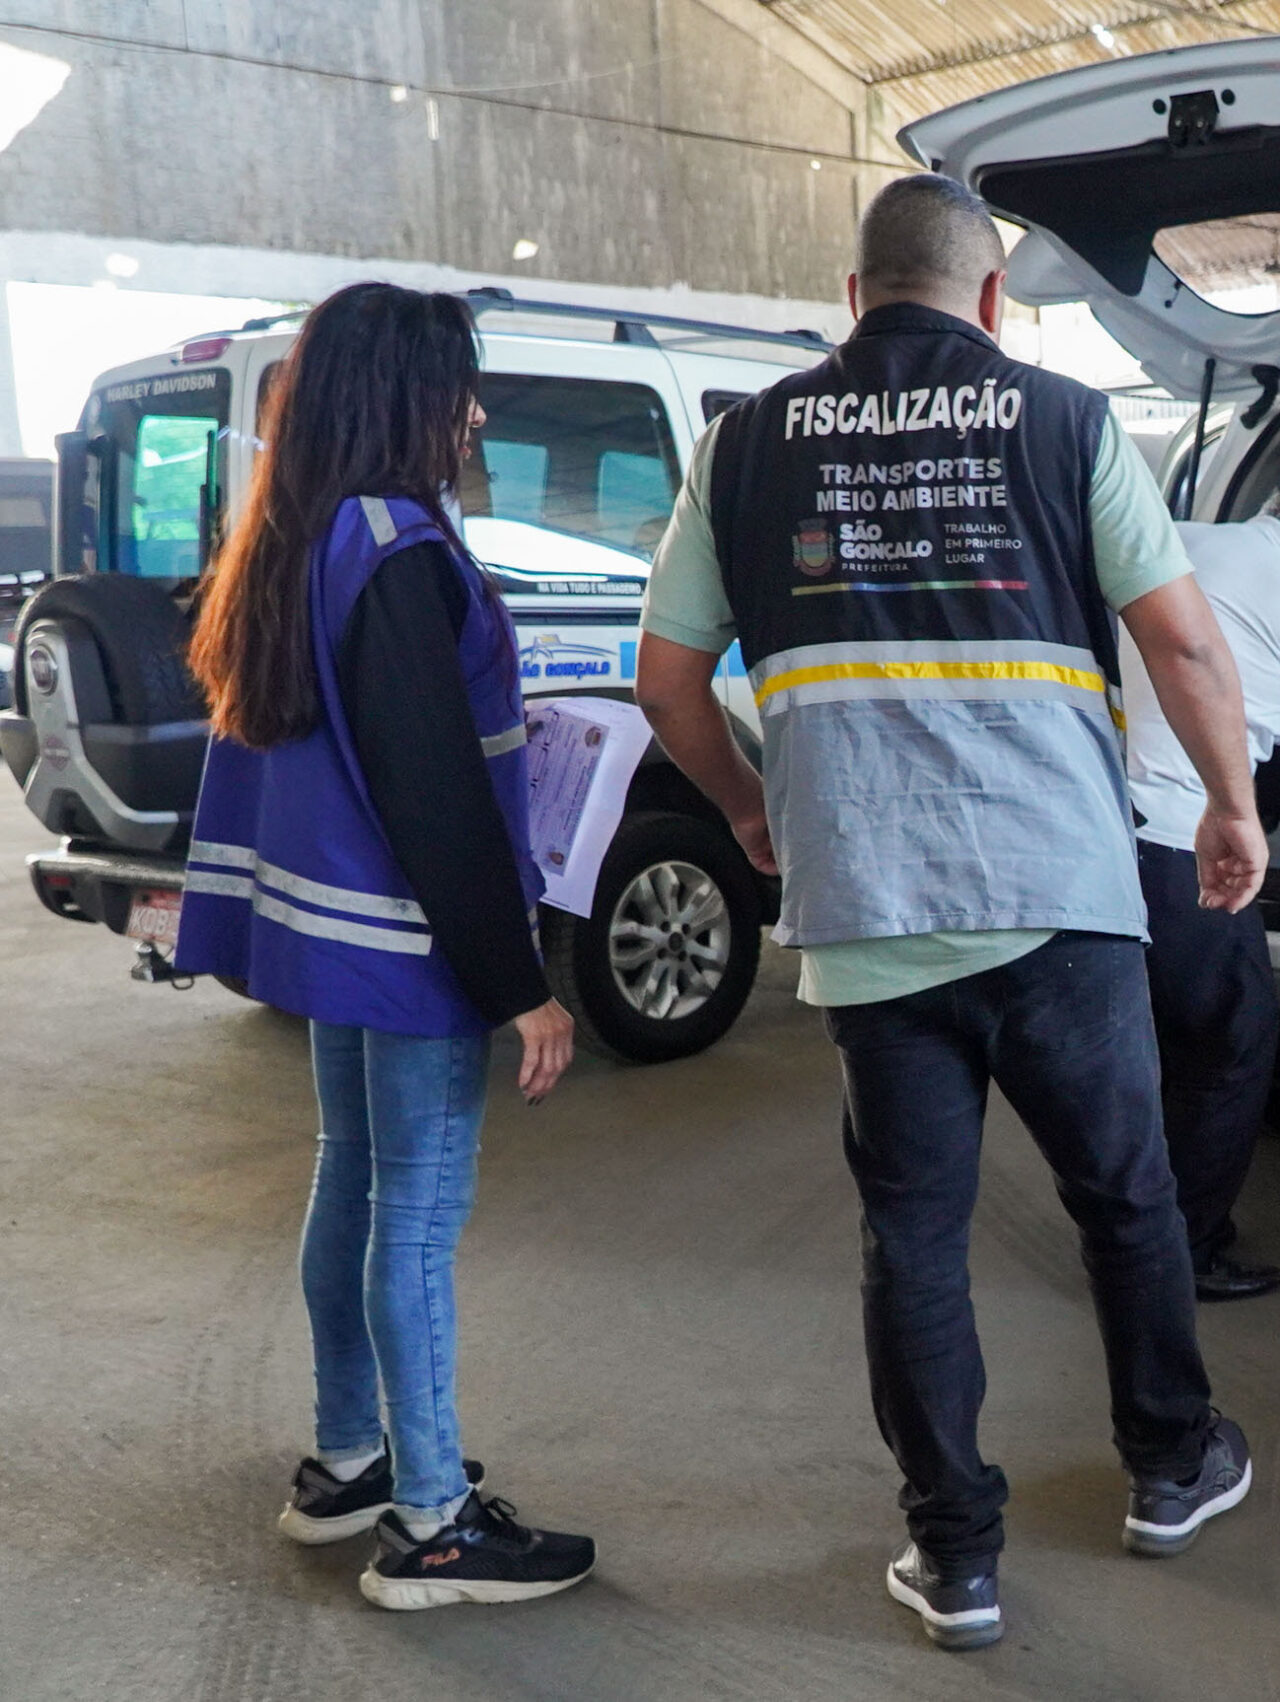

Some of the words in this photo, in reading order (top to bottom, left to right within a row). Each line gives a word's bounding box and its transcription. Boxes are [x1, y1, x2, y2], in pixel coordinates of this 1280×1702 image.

[107, 383, 151, 402] HARLEY
[153, 373, 216, 396] DAVIDSON
[785, 378, 1022, 441] FISCALIZAÇÃO
[819, 458, 1003, 485] TRANSPORTES
[816, 490, 877, 513] MEIO
[881, 484, 1008, 511] AMBIENTE
[839, 519, 882, 542] SÃO
[944, 523, 1007, 535] TRABALHO
[839, 539, 933, 561] GONÇALO
[945, 539, 962, 550] EM
[964, 537, 1023, 550] PRIMEIRO
[841, 562, 909, 573] PREFEITURA
[945, 553, 985, 564] LUGAR
[520, 660, 541, 678] ÃO
